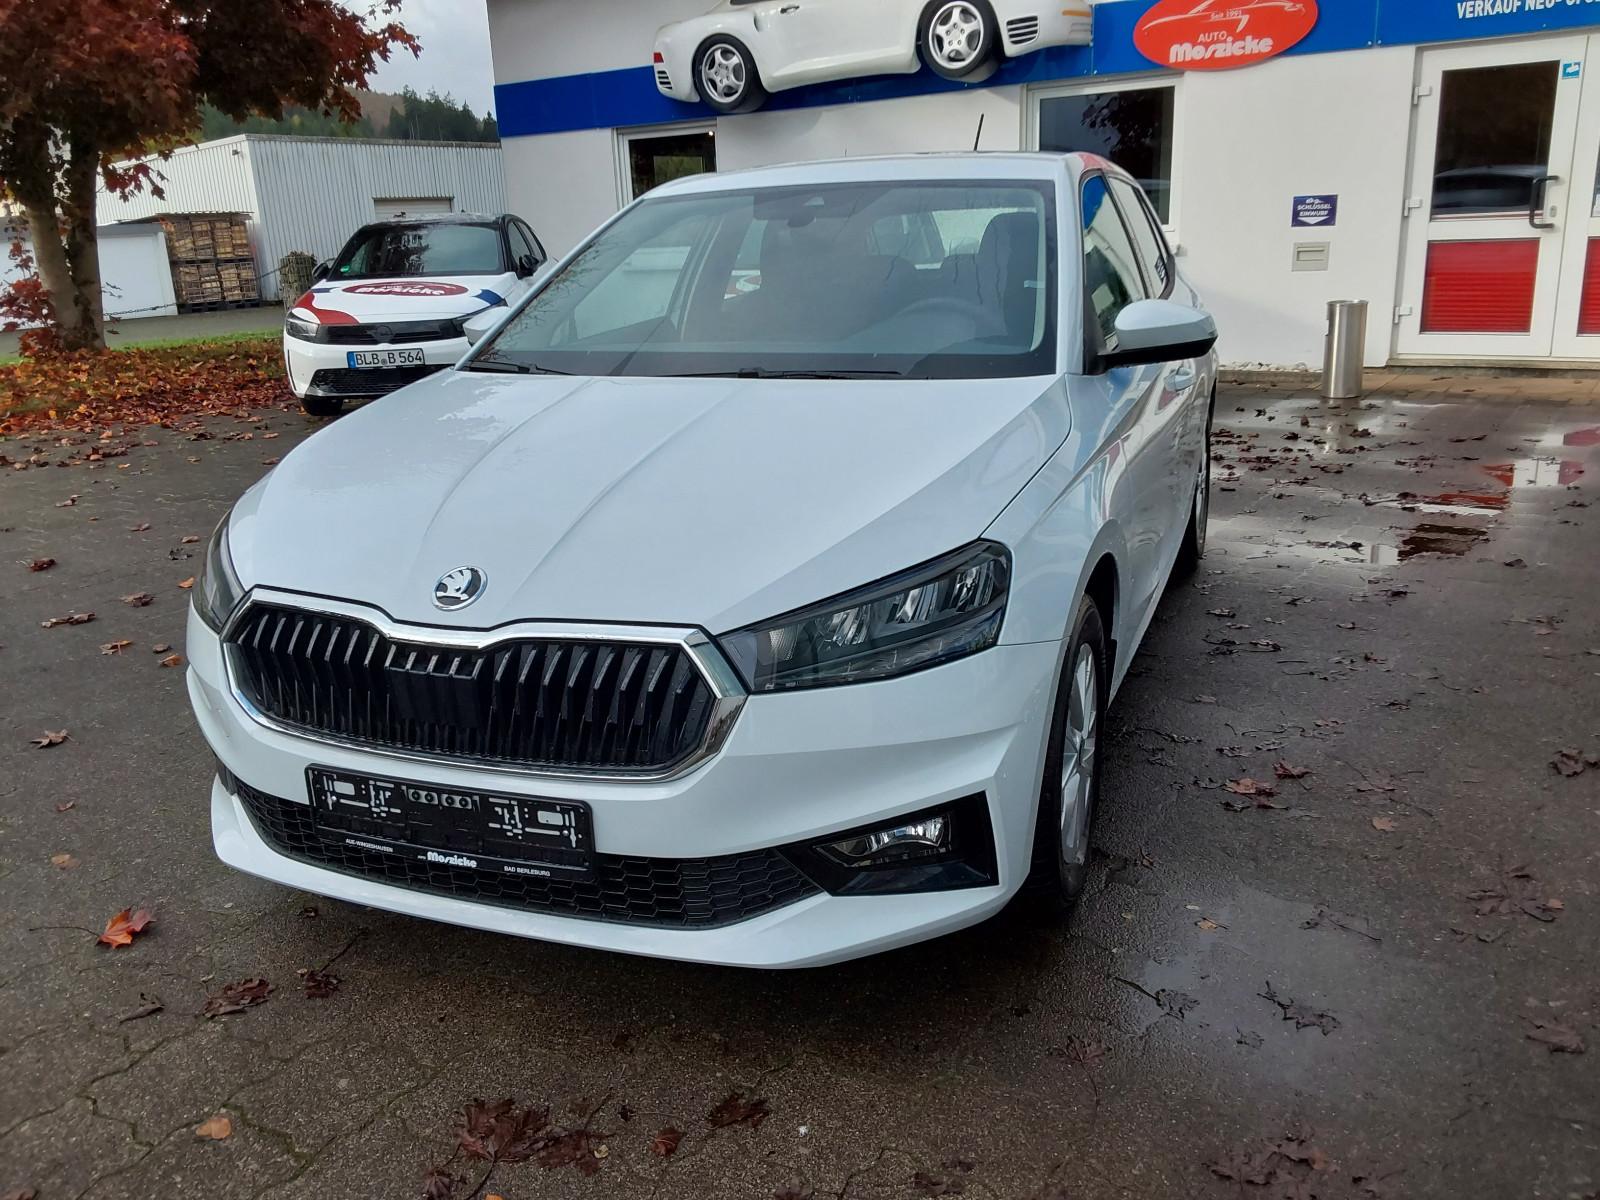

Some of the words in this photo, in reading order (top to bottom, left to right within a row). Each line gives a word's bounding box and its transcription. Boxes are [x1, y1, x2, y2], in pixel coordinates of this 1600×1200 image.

[1456, 0, 1521, 19] VERKAUF
[1197, 30, 1228, 43] AUTO
[355, 352, 380, 366] BLB
[387, 352, 397, 364] B
[398, 350, 422, 364] 564
[504, 865, 516, 873] BAD
